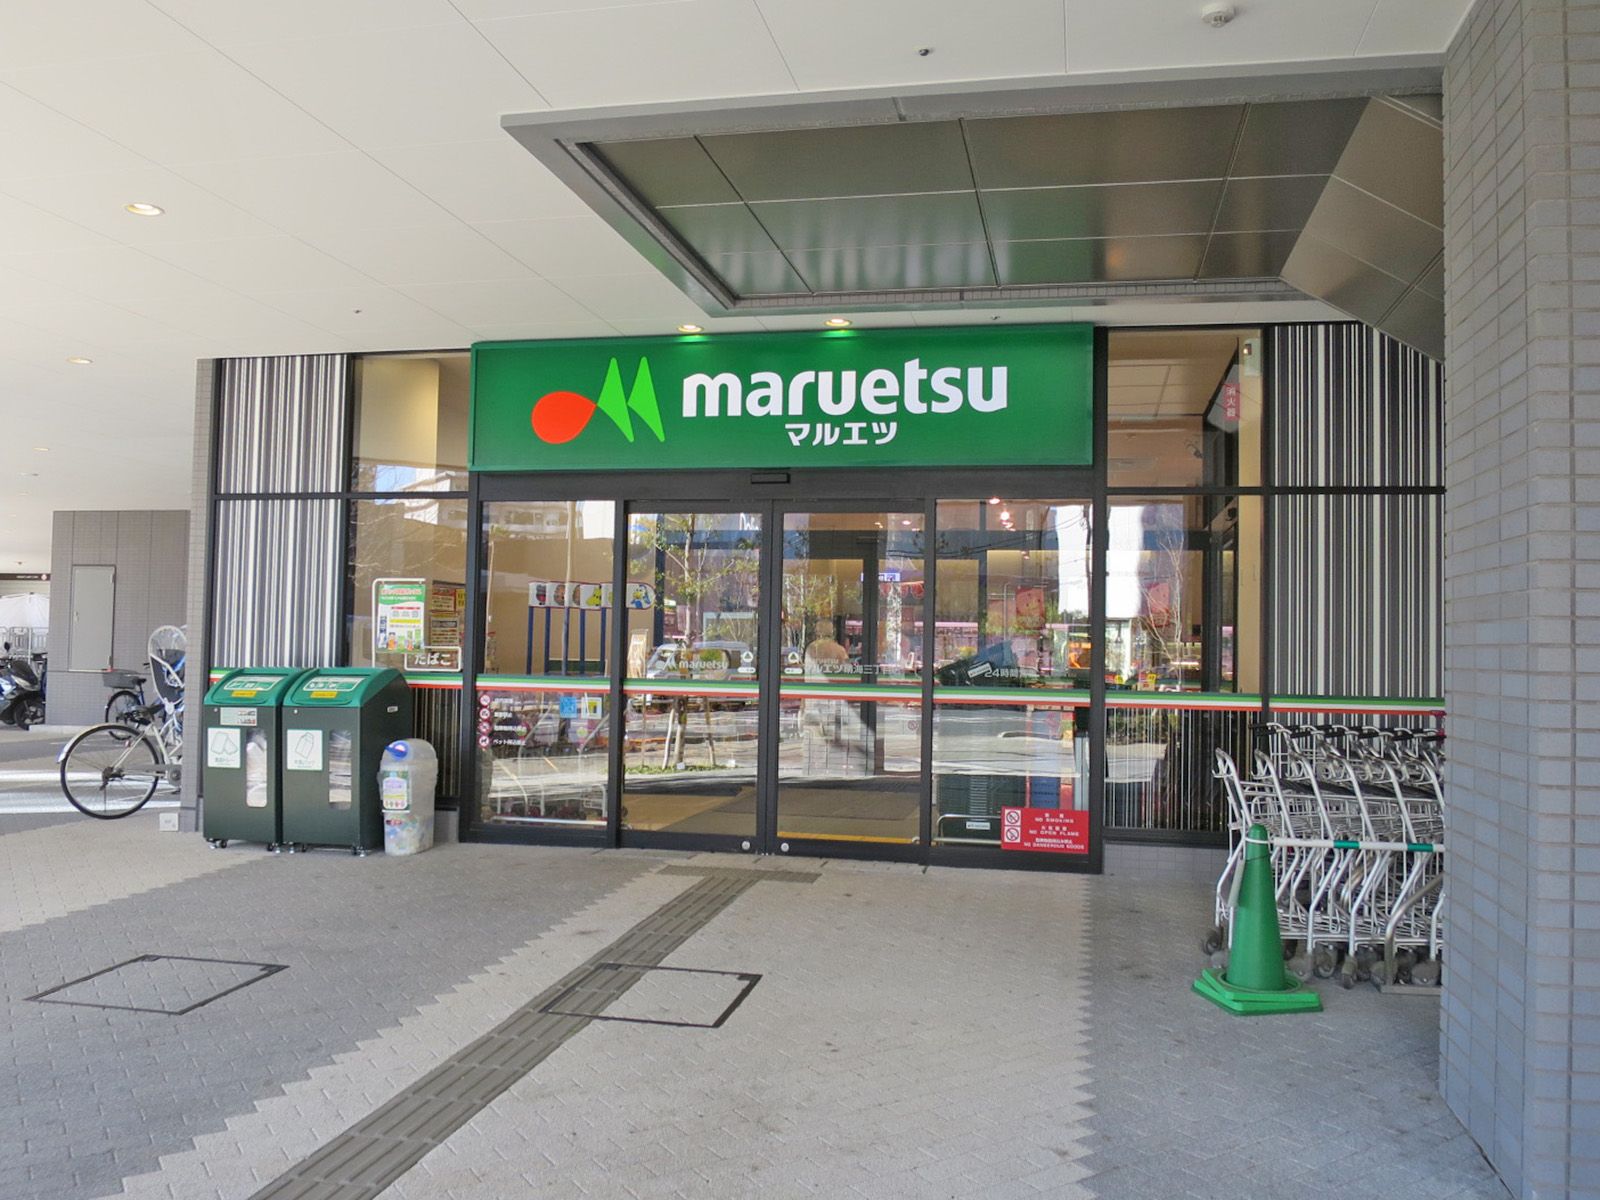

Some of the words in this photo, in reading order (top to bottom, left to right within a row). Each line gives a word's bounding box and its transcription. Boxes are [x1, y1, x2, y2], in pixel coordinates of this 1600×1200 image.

[682, 358, 1008, 418] maruetsu
[785, 421, 898, 447] マルエツ
[414, 653, 452, 666] たばこ
[679, 660, 729, 670] maruetsu
